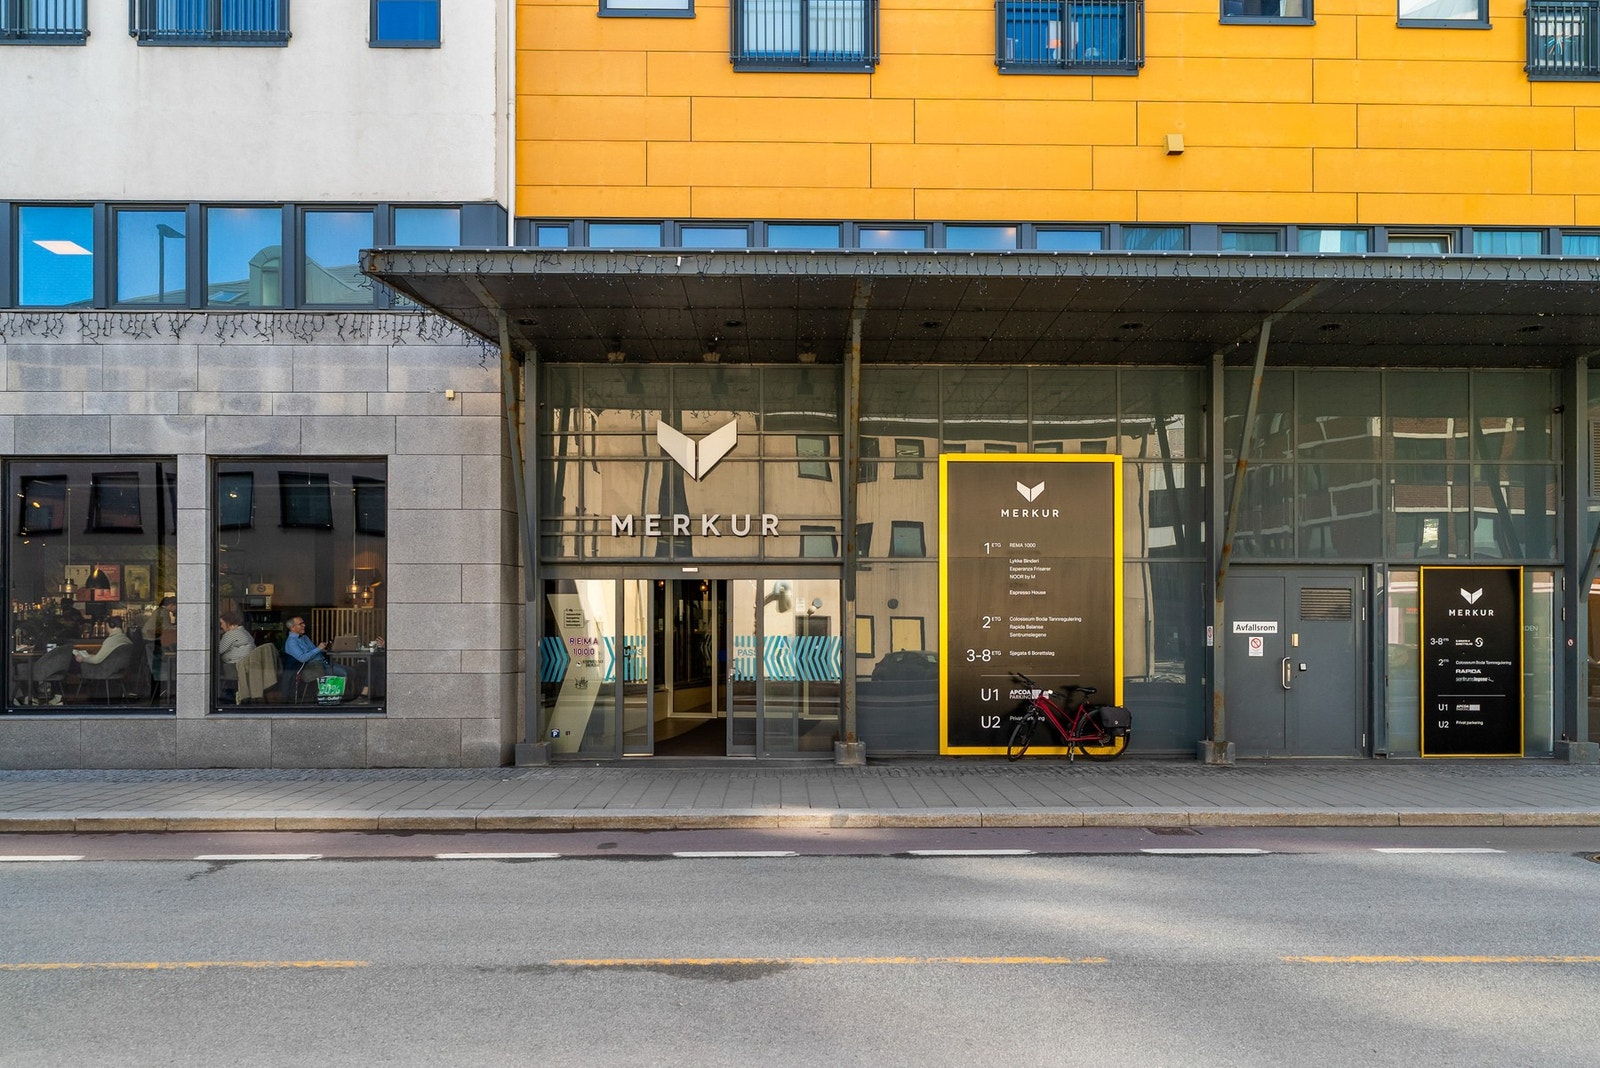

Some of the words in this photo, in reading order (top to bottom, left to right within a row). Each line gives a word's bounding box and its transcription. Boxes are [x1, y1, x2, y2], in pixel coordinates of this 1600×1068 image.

[1001, 509, 1060, 518] MERKUR
[611, 514, 779, 537] MERKUR
[984, 542, 990, 555] 1
[1448, 609, 1495, 617] MERKUR
[982, 616, 991, 629] 2
[569, 637, 599, 645] REMA
[1430, 637, 1443, 646] 3-8
[573, 648, 595, 656] 1000
[966, 649, 991, 662] 3-8
[981, 688, 1000, 701] U1
[1438, 703, 1448, 711] U1
[981, 715, 1001, 729] U2
[1438, 720, 1449, 728] U2
